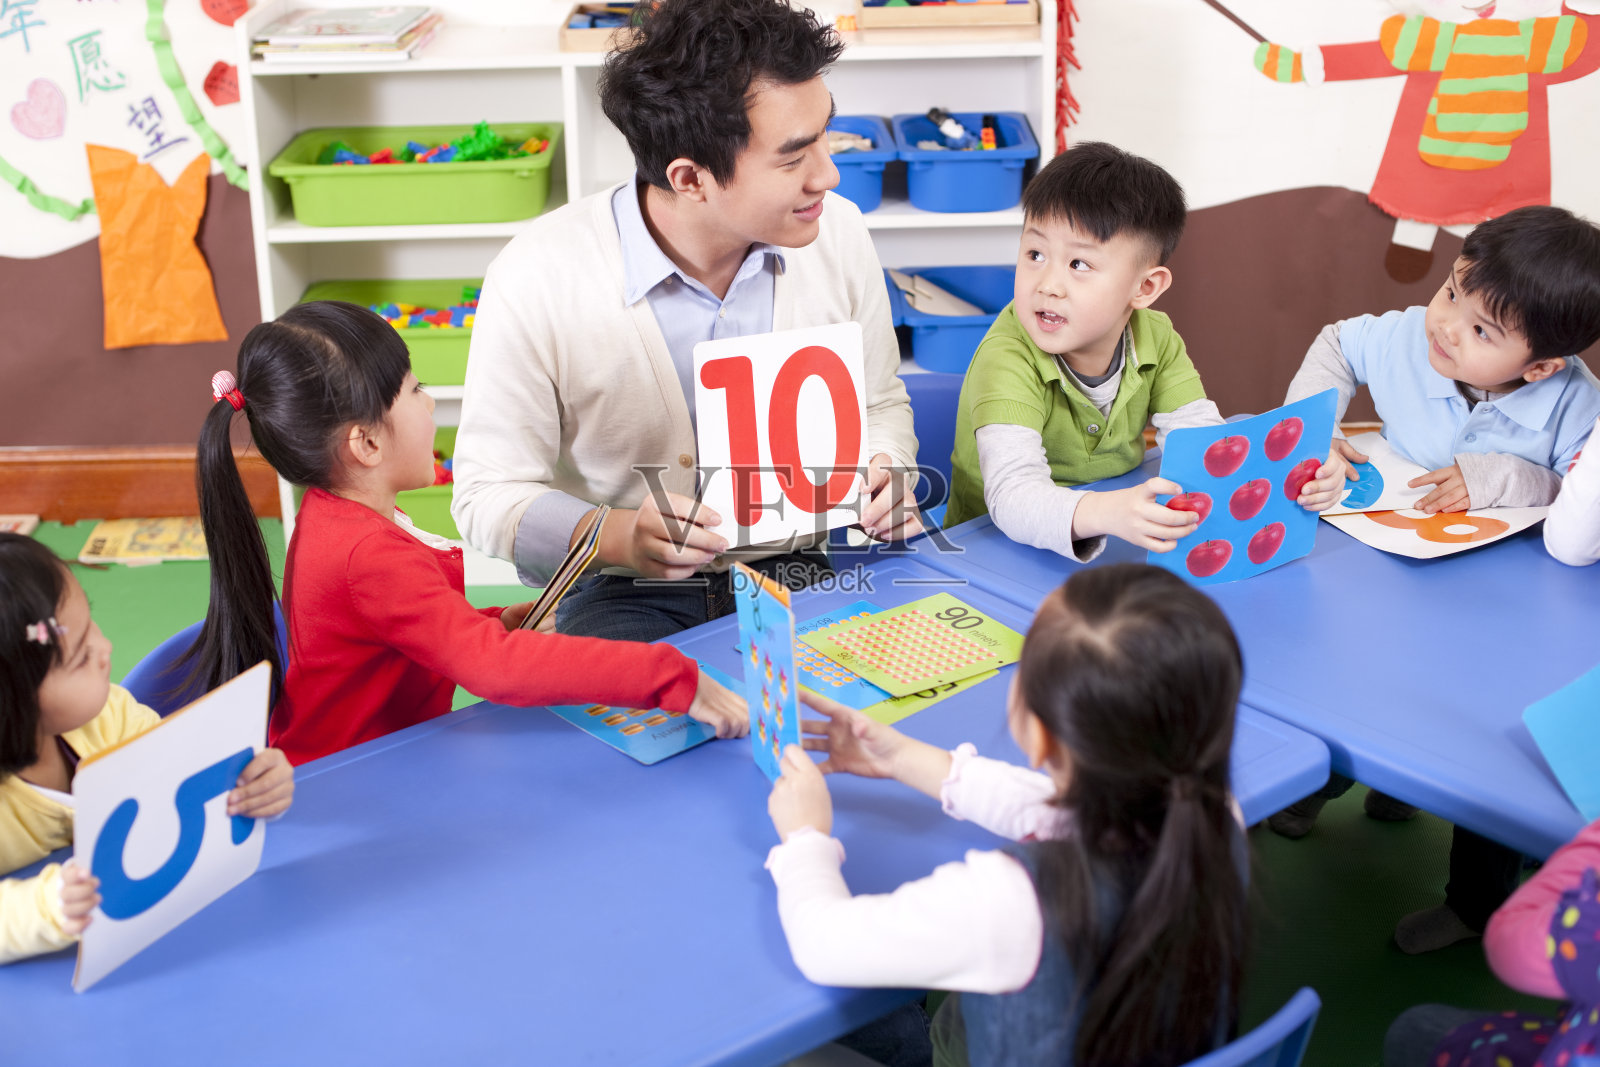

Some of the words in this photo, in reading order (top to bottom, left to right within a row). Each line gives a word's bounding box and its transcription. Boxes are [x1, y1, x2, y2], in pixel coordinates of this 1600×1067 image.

[700, 345, 862, 527] 10
[935, 607, 984, 630] 90
[968, 629, 1001, 647] ninety
[90, 746, 256, 921] 5
